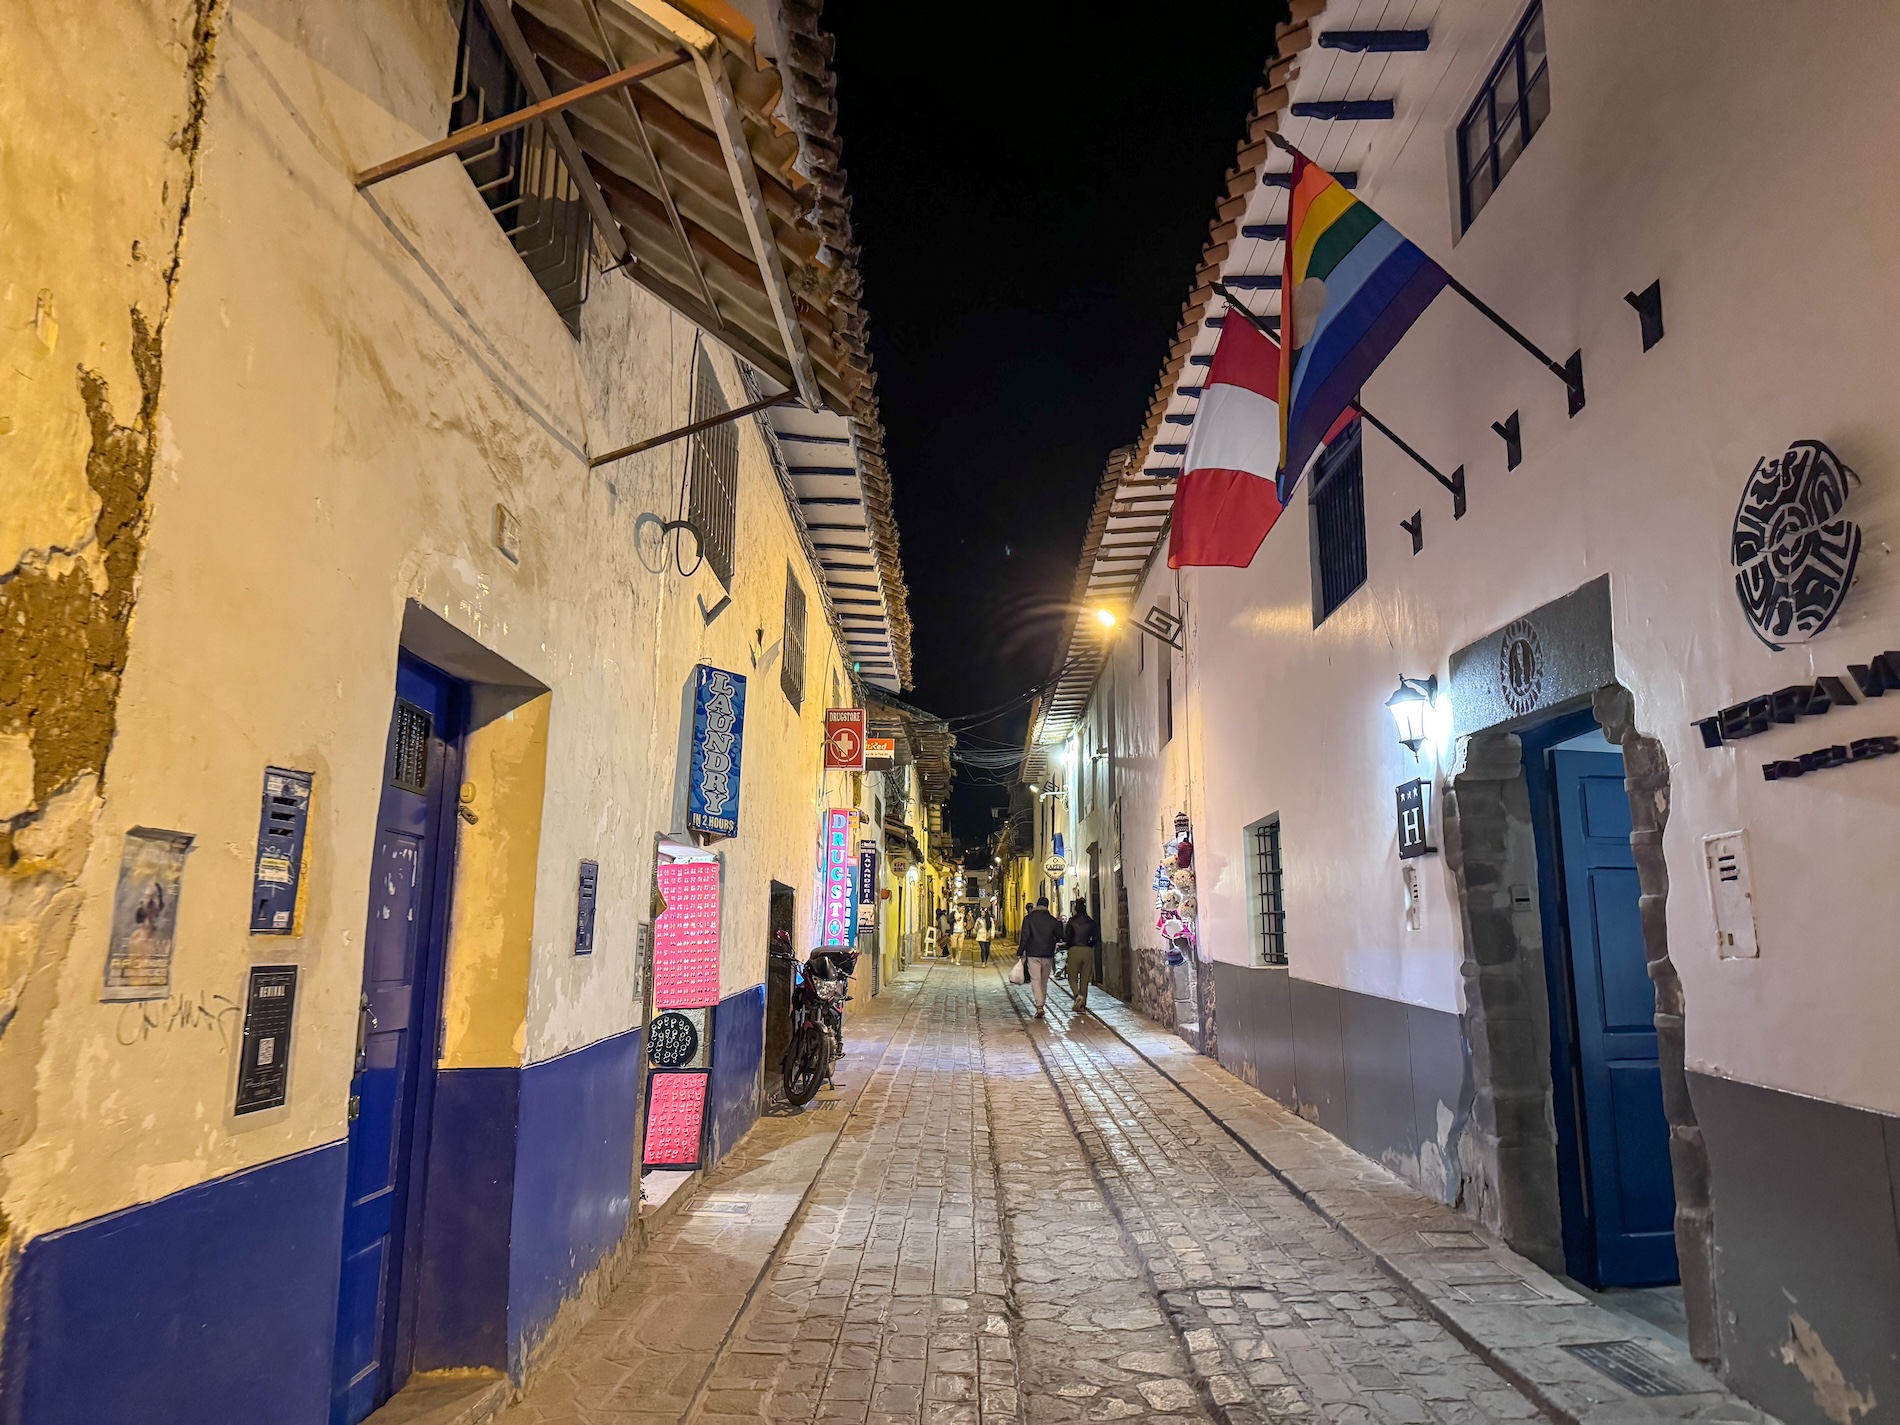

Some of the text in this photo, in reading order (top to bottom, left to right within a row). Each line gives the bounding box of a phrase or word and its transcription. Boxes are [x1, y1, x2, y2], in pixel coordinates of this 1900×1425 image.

[829, 712, 861, 722] DRUGSTORE
[702, 671, 735, 815] LAUNDRY
[692, 813, 735, 832] IN 2 HOURS
[1402, 807, 1422, 847] H
